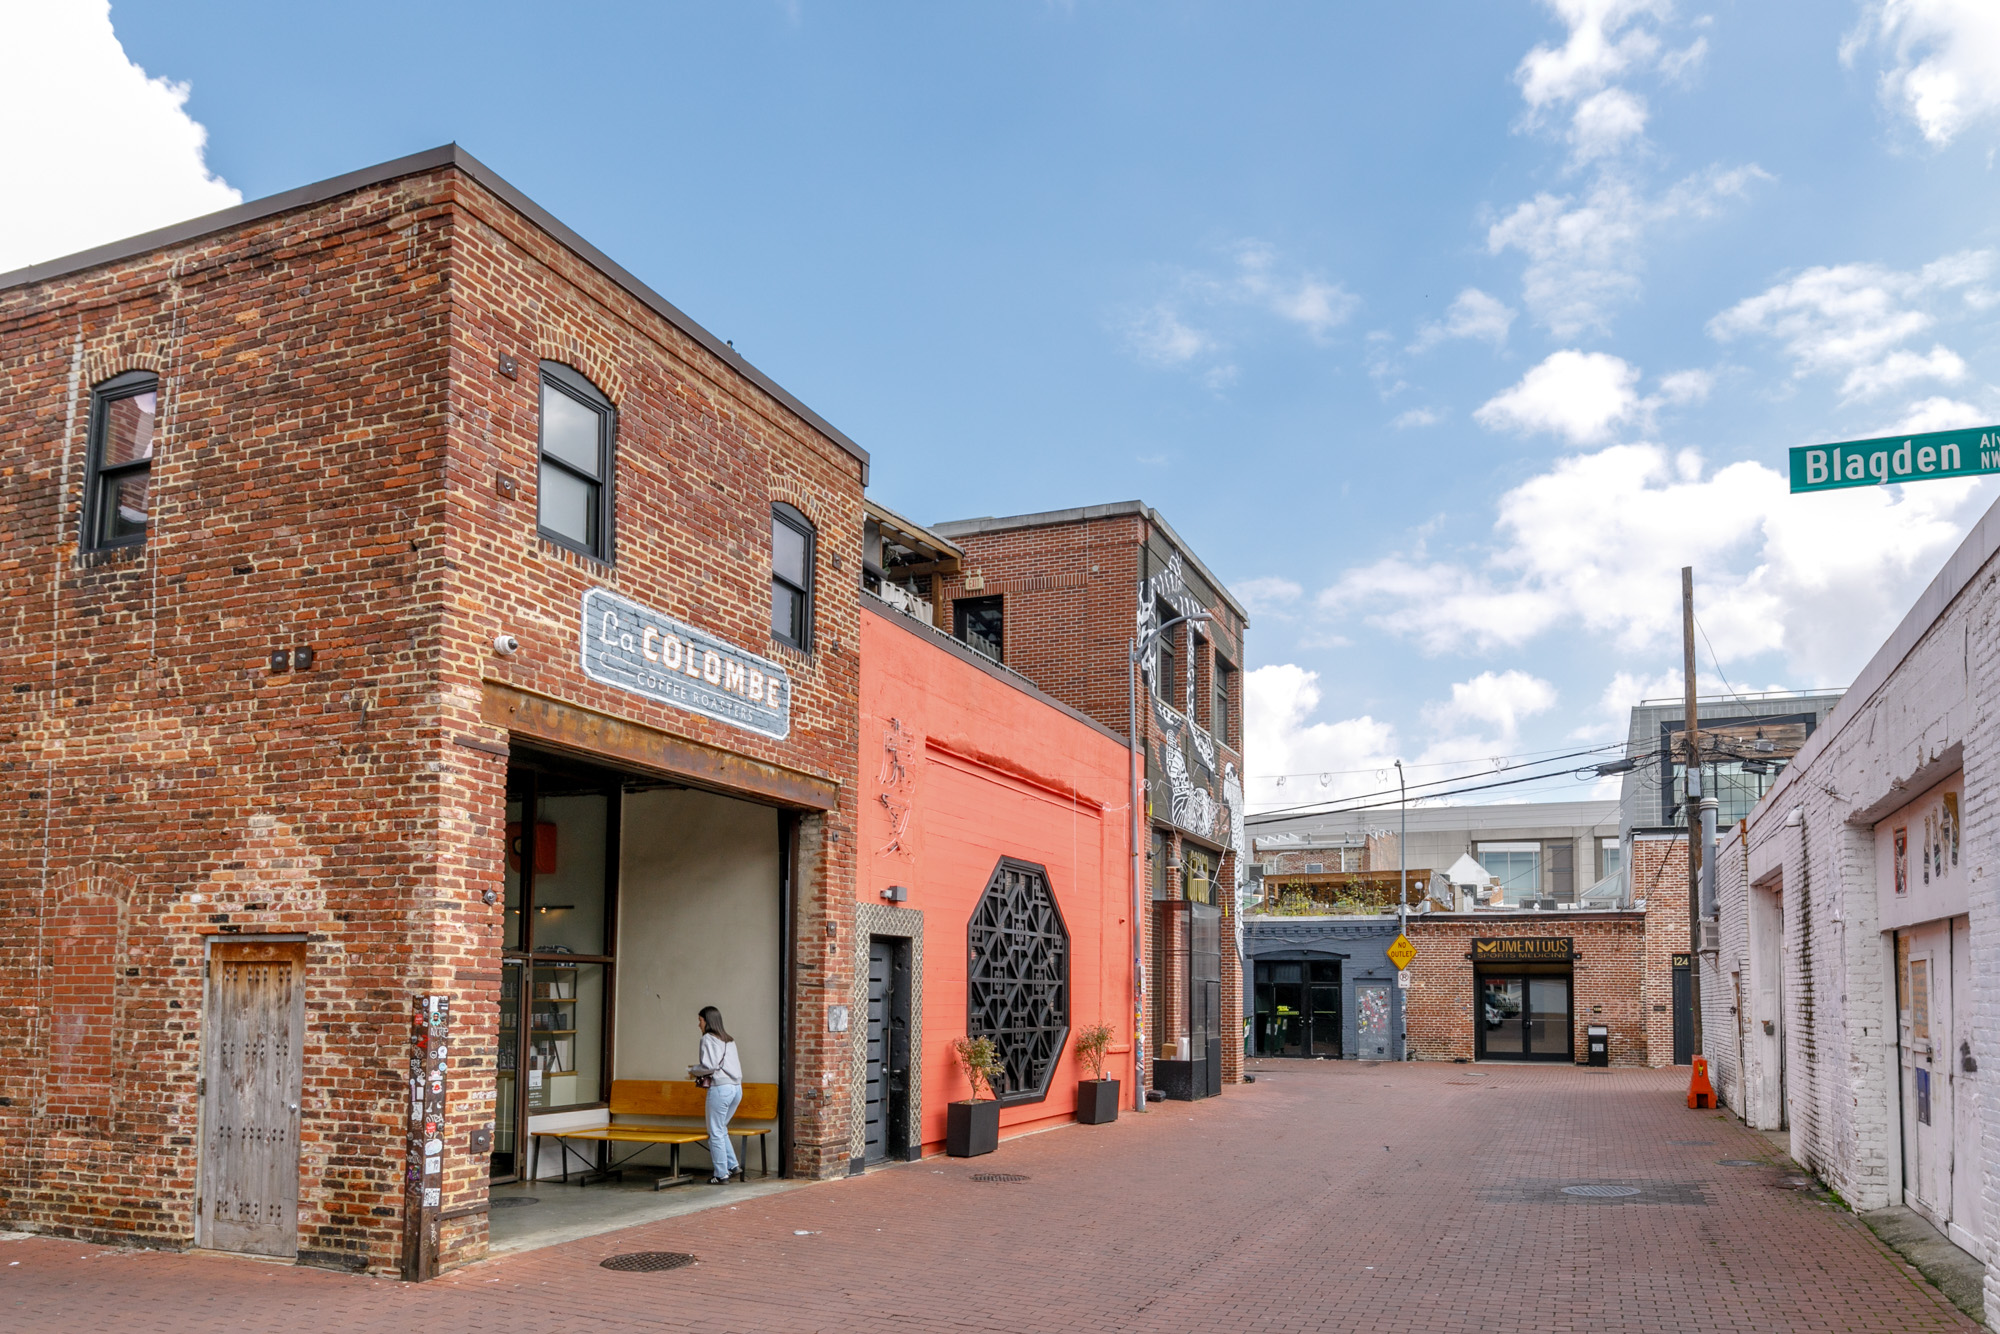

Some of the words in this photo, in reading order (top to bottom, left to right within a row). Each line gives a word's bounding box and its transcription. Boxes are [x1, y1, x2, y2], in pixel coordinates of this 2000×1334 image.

[1806, 440, 1961, 485] Blagden
[599, 611, 635, 653] La
[642, 625, 781, 709] COLOMBE
[637, 672, 687, 700] COFFEE
[693, 691, 754, 722] ROASTERS
[1391, 950, 1413, 958] OUTLET
[1397, 941, 1406, 949] NO
[1673, 957, 1689, 966] 124
